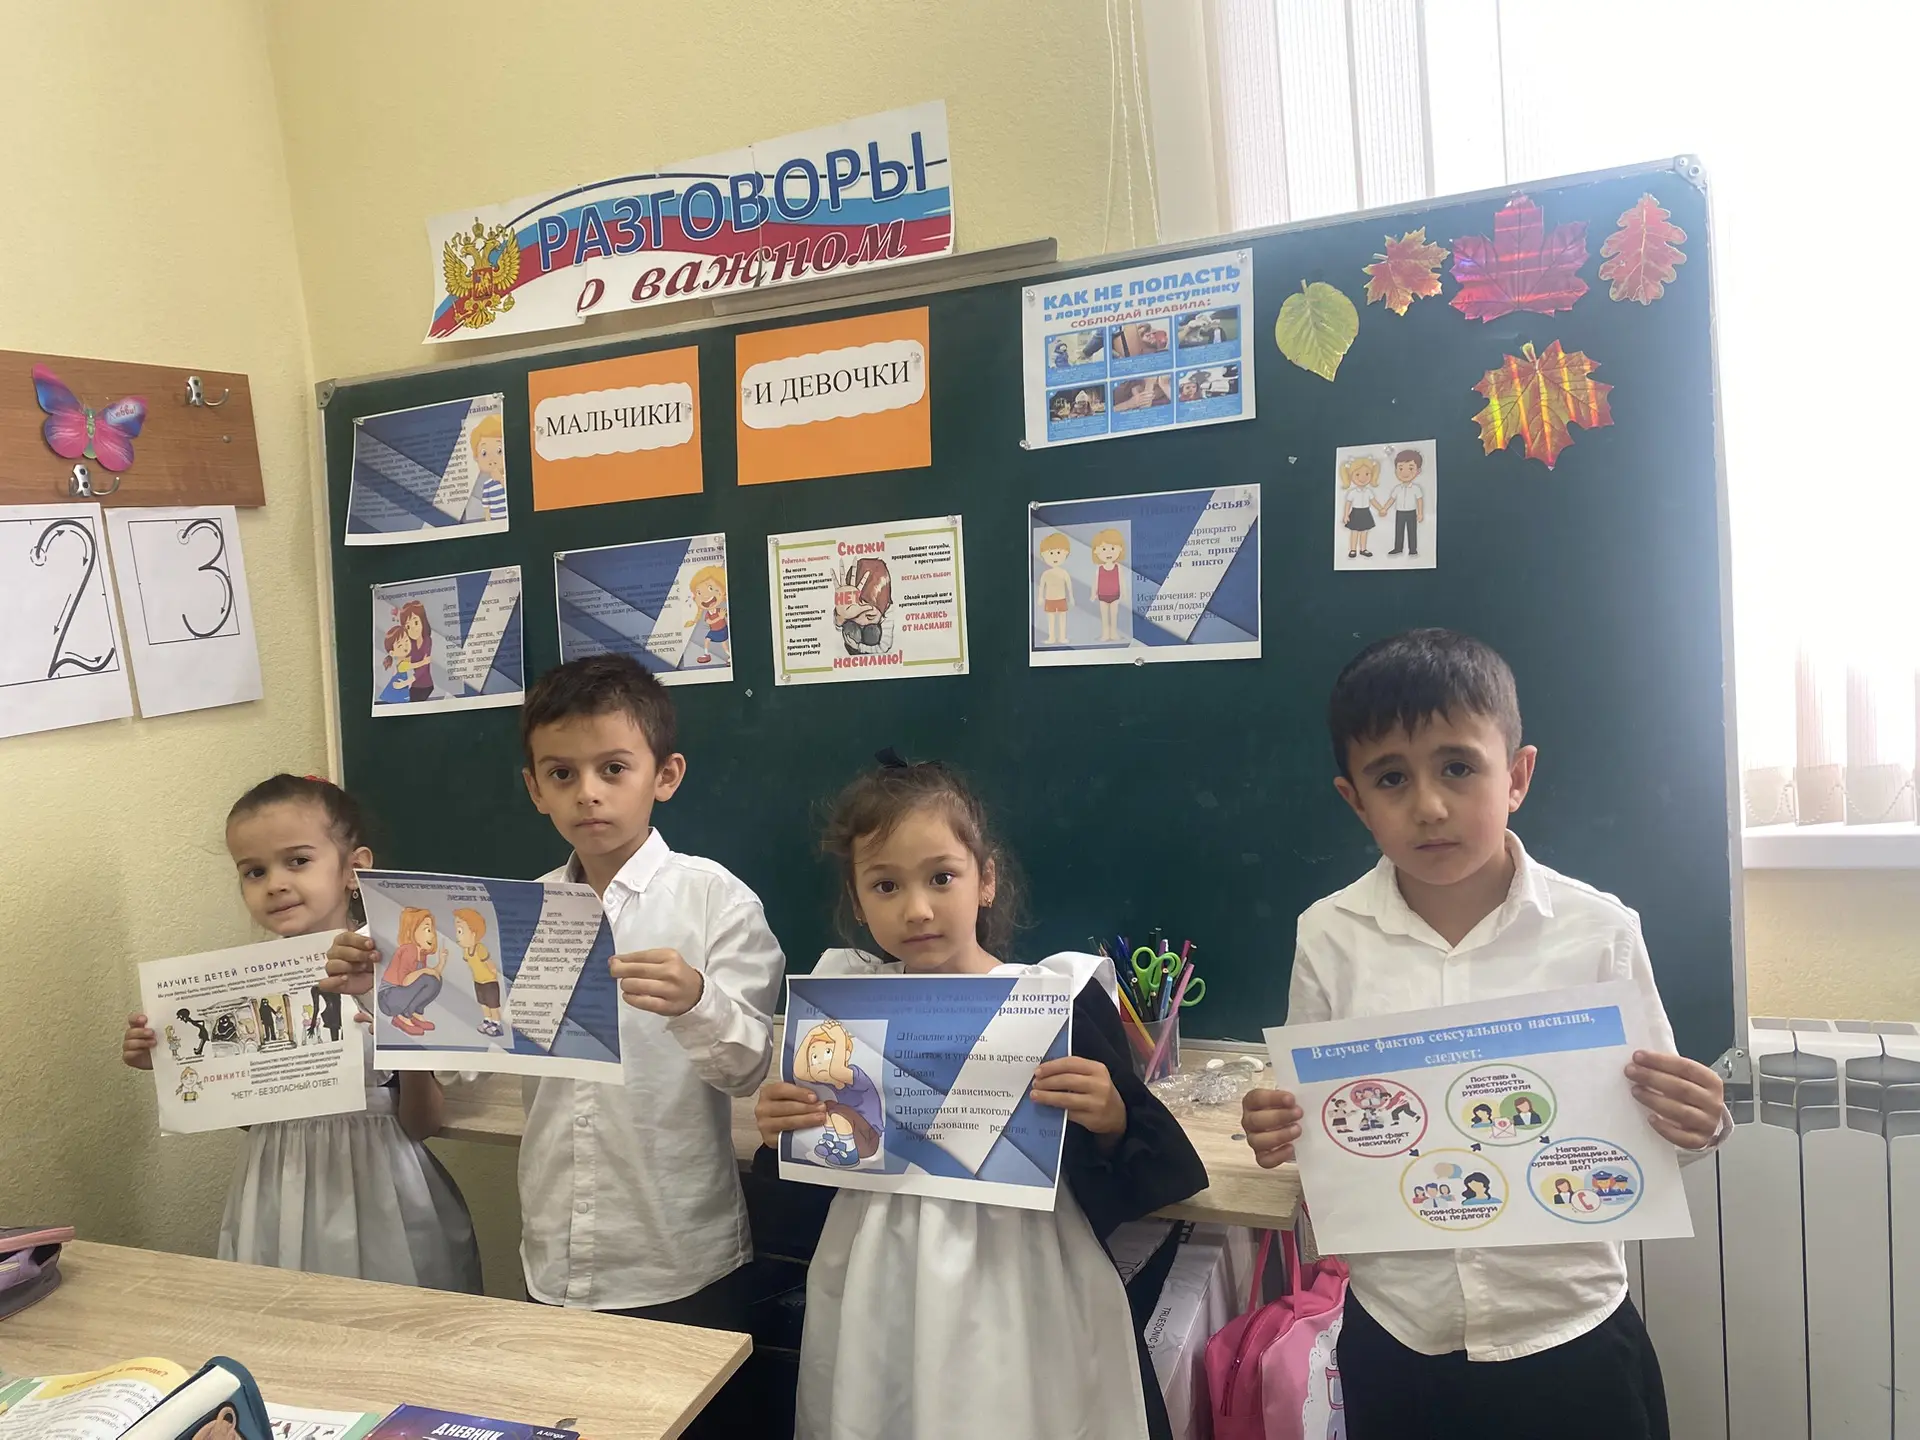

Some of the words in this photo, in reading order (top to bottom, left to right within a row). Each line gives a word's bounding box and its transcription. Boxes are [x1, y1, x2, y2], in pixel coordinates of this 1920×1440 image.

[537, 131, 928, 272] РАЗГОВОРЫ
[577, 278, 603, 312] о
[631, 219, 907, 301] важном
[1043, 289, 1089, 311] КАК
[1094, 284, 1123, 302] НЕ
[1129, 264, 1241, 291] ПОПАСТЬ
[1044, 313, 1052, 322] в
[1055, 301, 1121, 320] ловушку
[1124, 299, 1134, 309] к
[1137, 280, 1240, 307] преступнику
[1070, 308, 1142, 329] СОБЛЮДАЙ
[1145, 298, 1211, 316] ПРАВИЛА:
[754, 383, 773, 405] И
[779, 360, 910, 405] ДЕВОЧКИ
[546, 401, 682, 437] МАЛЬЧИКИ
[837, 541, 885, 556] Скажи
[181, 519, 233, 638] 3
[36, 519, 115, 678] 2
[834, 590, 862, 606] НЕТ
[905, 610, 948, 621] ОТКАЖИСЬ
[902, 624, 912, 632] ОТ
[913, 621, 952, 631] НАСИЛИЯ!
[833, 650, 904, 668] насилию!
[157, 975, 200, 989] НАУЧИТЕ
[204, 967, 238, 982] ДЕТЕЙ
[244, 958, 300, 974] ГОВОРИТЬ
[998, 1006, 1045, 1017] разные
[1311, 1047, 1322, 1059] В
[1325, 1043, 1370, 1059] случае
[1374, 1035, 1425, 1053] фактов
[1428, 1021, 1522, 1043] сексуального
[1528, 1012, 1596, 1030] насилия,
[996, 1055, 1024, 1064] адрес
[1425, 1048, 1482, 1064] следует:
[258, 1080, 311, 1096] БЕЗОПАСНЫЙ
[312, 1077, 339, 1088] ОТВЕТ!
[1465, 1079, 1525, 1090] известность
[1470, 1074, 1508, 1083] Поставь
[1462, 1084, 1531, 1097] руководителя
[904, 1106, 958, 1117] Наркотики
[904, 1121, 980, 1130] Использование
[1347, 1134, 1383, 1142] Выявил
[1385, 1132, 1409, 1140] факт
[1358, 1138, 1402, 1147] насилия?
[1531, 1159, 1568, 1168] органы
[1569, 1155, 1629, 1165] внутренних
[1539, 1151, 1608, 1161] информацию
[1149, 1307, 1172, 1343] TRUESONIC
[431, 1422, 504, 1440] ДНЕВНИК
